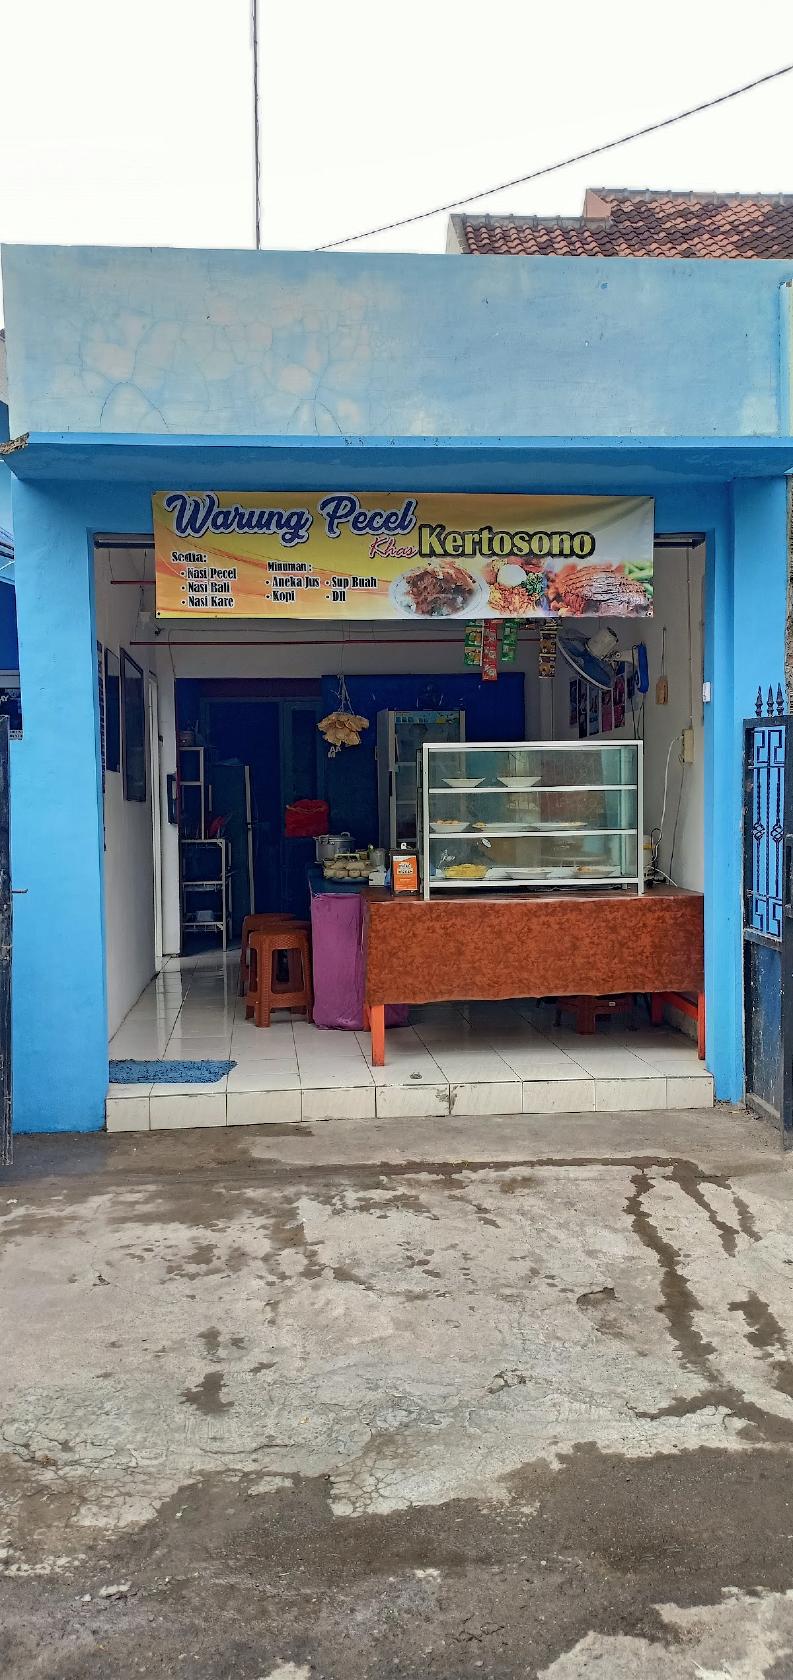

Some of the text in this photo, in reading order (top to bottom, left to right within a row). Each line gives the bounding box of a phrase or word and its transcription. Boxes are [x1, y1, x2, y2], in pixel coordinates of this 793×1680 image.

[164, 493, 417, 546] Warung Pecel
[369, 524, 595, 558] Khas Kertosono
[171, 551, 207, 563] Sedia:
[267, 561, 307, 572] Minuman
[187, 567, 237, 580] Nasi Pecel
[187, 581, 208, 593] Nasi
[272, 576, 320, 589] Aneka Jus
[331, 576, 377, 589] Sup Buah
[188, 596, 234, 607] Nasi Kare
[272, 590, 295, 603] Kopi
